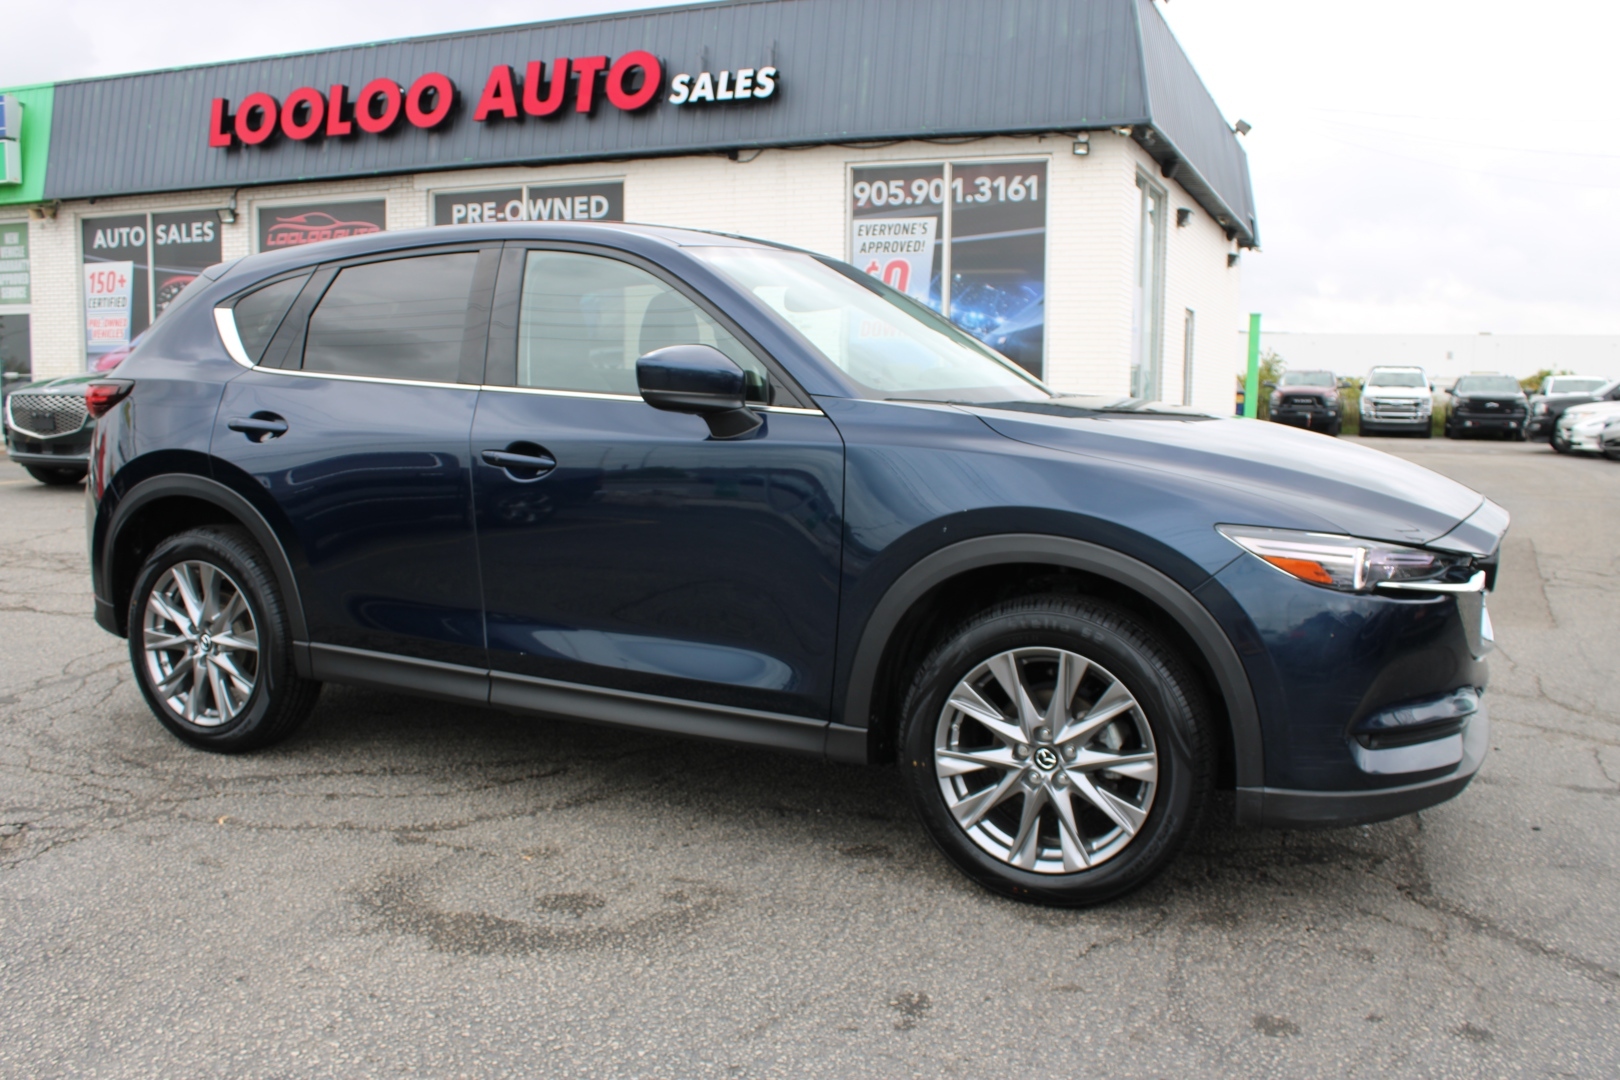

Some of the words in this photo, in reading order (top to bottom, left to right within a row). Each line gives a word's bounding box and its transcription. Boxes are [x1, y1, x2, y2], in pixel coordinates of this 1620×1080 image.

[209, 72, 454, 147] LOOLOO
[473, 50, 662, 122] AUTO
[669, 66, 777, 105] SALES
[853, 175, 1039, 207] 905.901.3161
[451, 194, 610, 224] PRE-OWNED
[93, 226, 146, 250] AUTO
[156, 221, 215, 246] SALES
[857, 221, 929, 238] EVERYONE'S
[859, 239, 926, 255] APPROVED!
[88, 269, 127, 295] 150+
[88, 296, 128, 309] CERTIFIED
